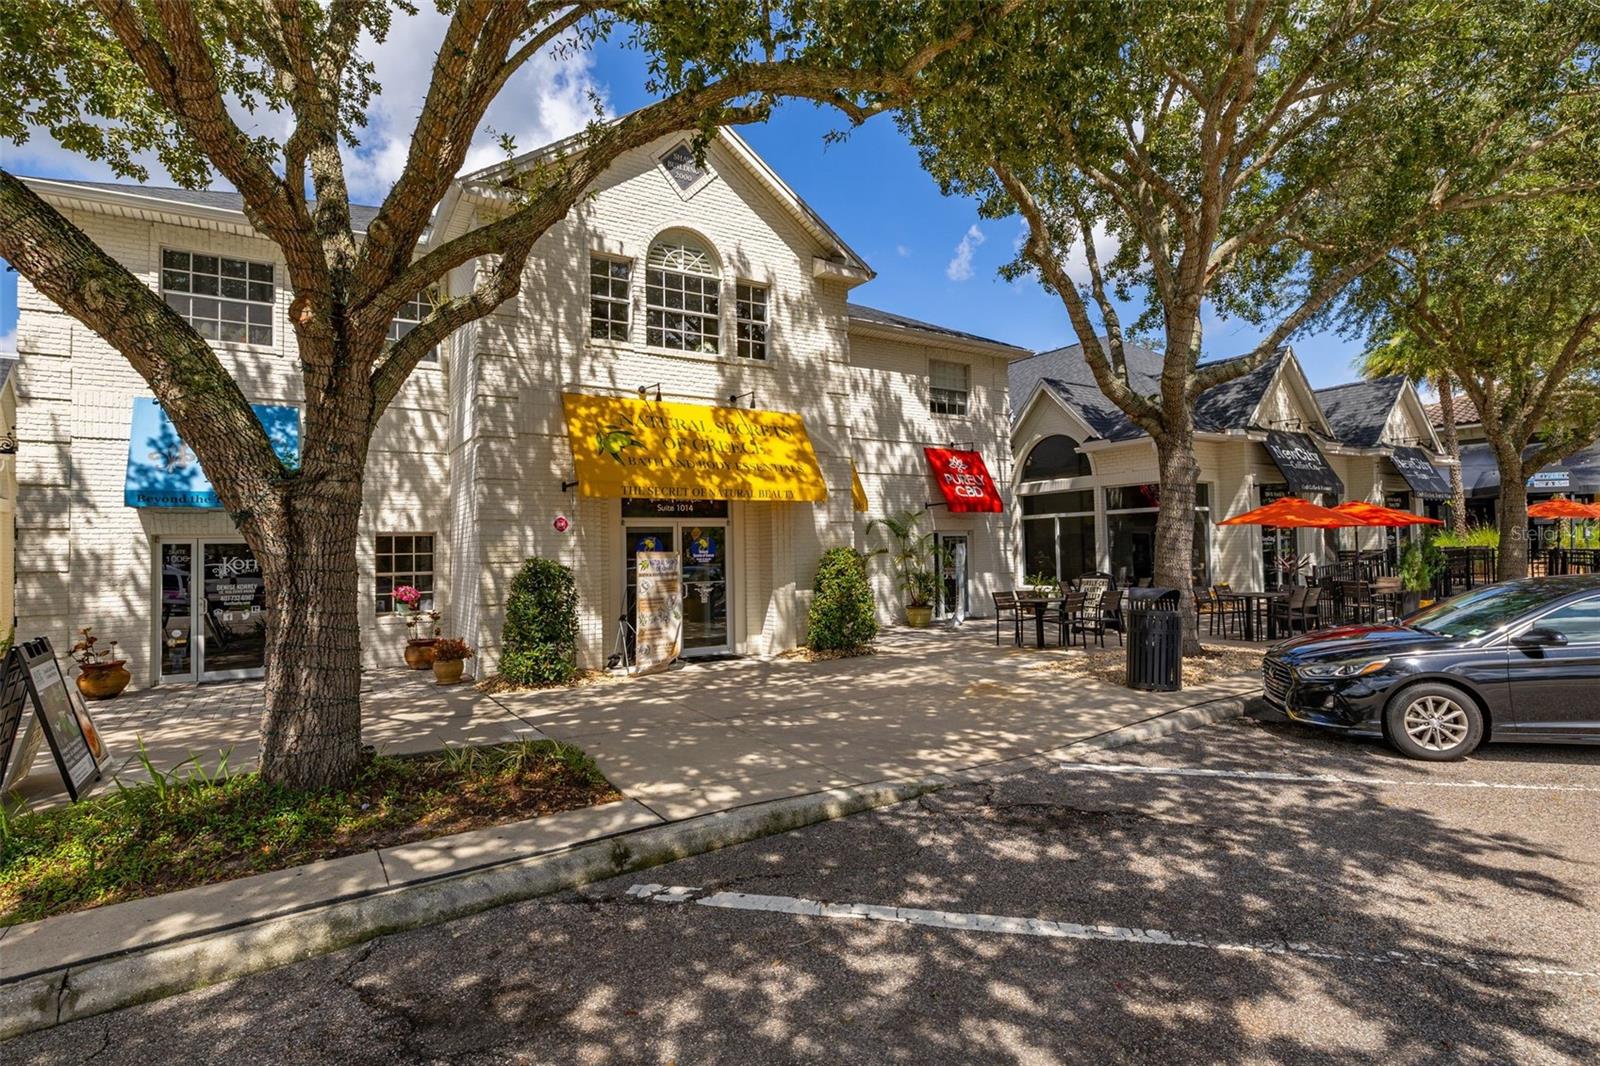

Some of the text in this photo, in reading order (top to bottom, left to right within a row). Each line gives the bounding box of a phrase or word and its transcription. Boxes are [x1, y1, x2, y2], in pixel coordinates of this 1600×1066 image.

[619, 412, 792, 437] NATURAL SECRETS
[662, 436, 766, 455] OF GREECE
[628, 456, 804, 473] BATH AND BODY ESSENTIALS
[943, 473, 985, 486] PURELY
[622, 486, 794, 499] THE SECRET OF NATURAL BEAUTY
[955, 485, 984, 497] CBD
[137, 493, 187, 505] Beyond
[189, 493, 209, 504] the
[657, 503, 694, 512] Suite 1014
